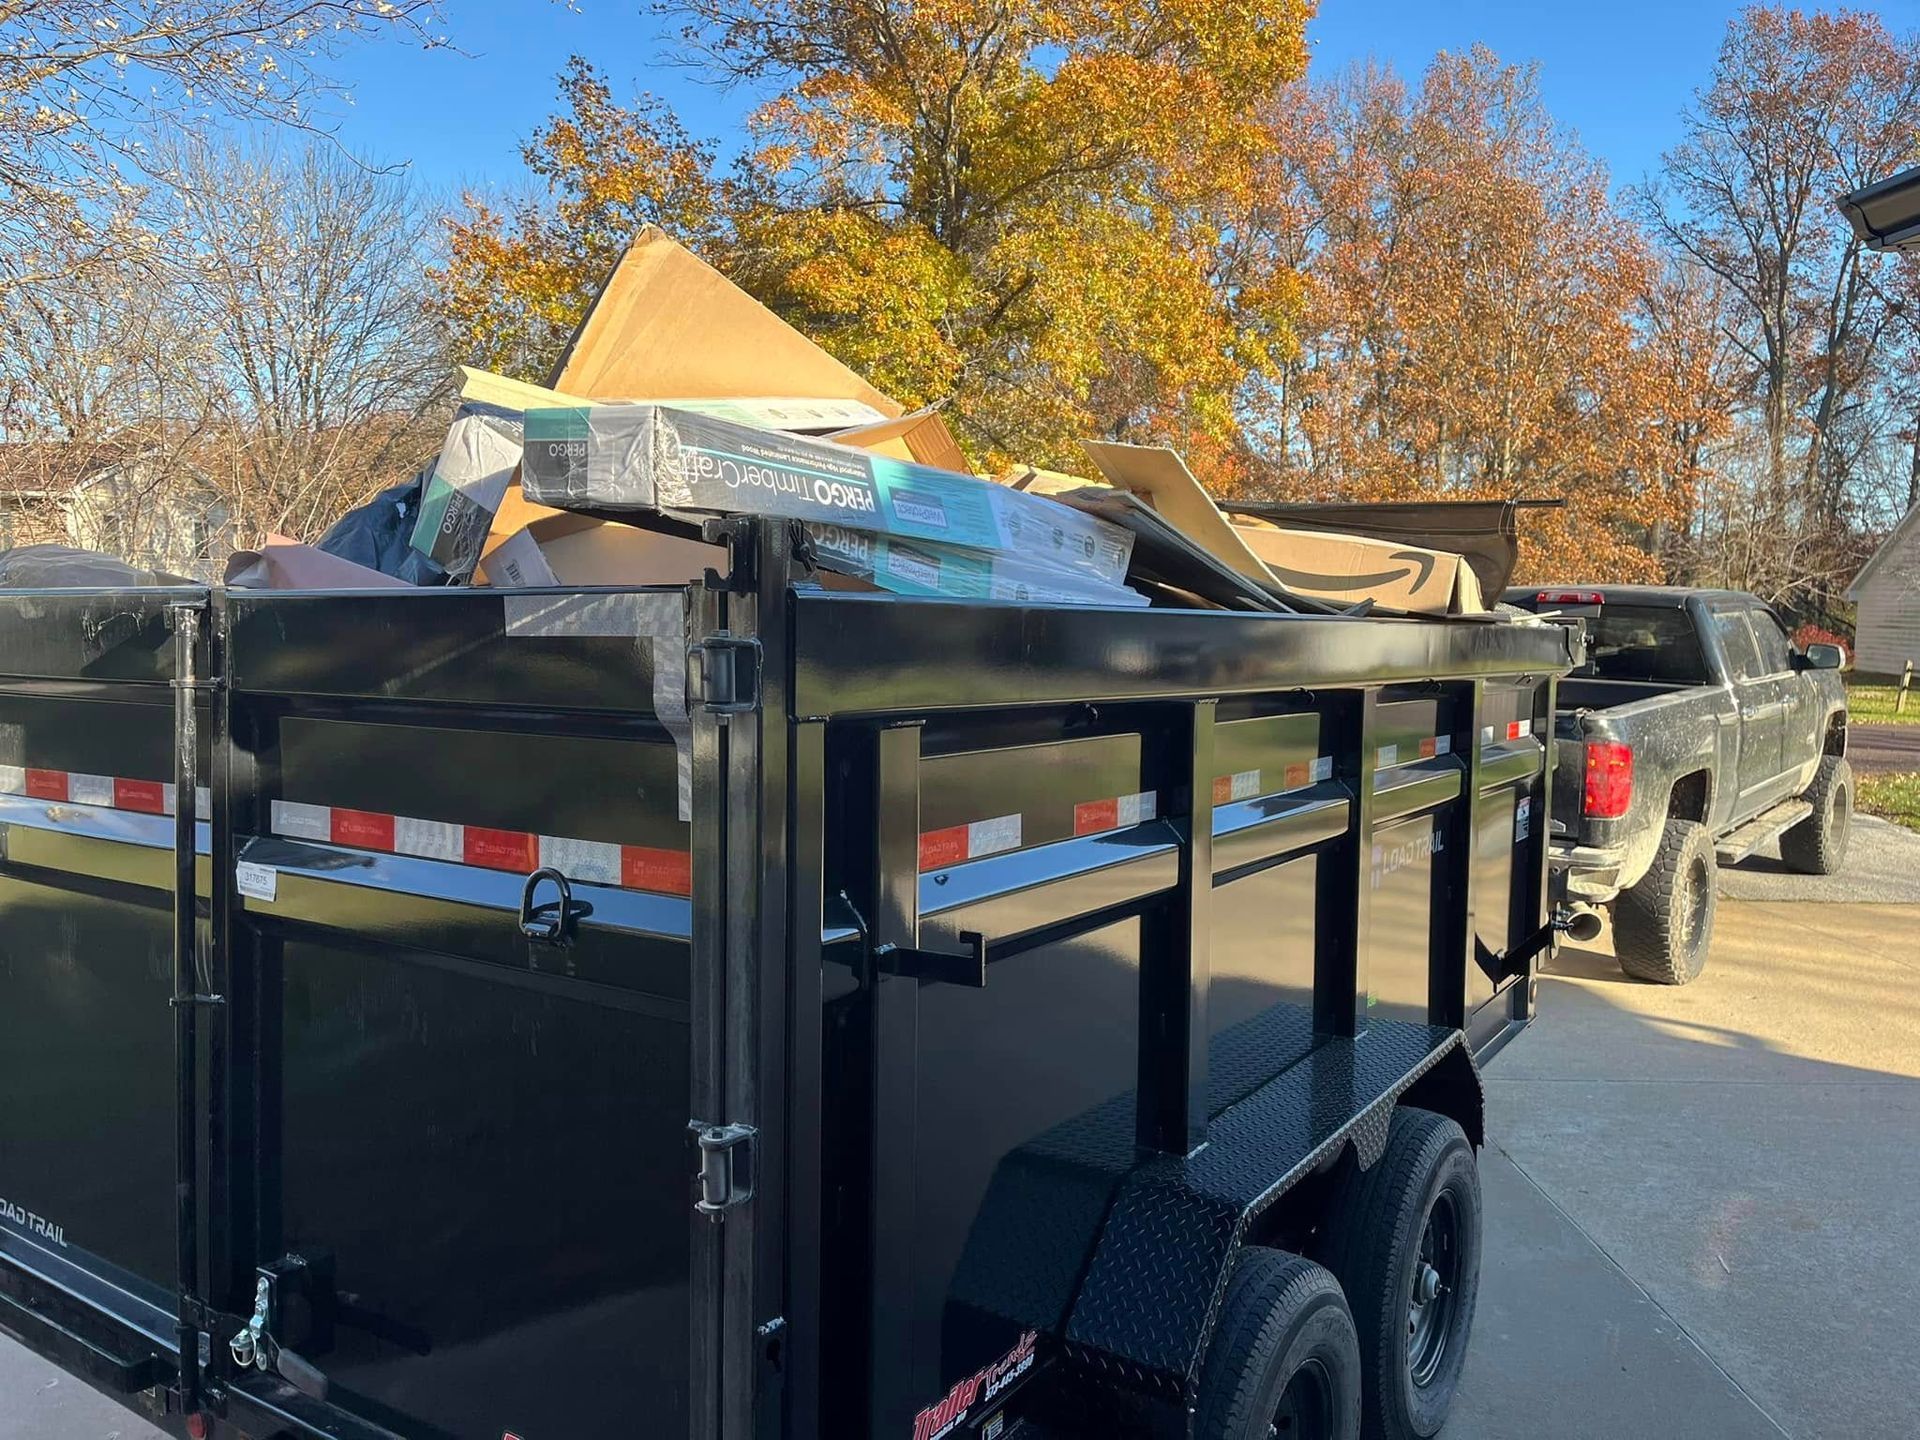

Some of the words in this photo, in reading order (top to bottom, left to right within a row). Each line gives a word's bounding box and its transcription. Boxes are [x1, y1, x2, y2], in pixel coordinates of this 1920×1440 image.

[549, 443, 586, 457] PERGO
[680, 450, 815, 502] TimberCraft
[815, 479, 877, 513] PERGO
[443, 491, 464, 534] PERGO
[0, 1197, 26, 1226] OAD
[27, 1211, 68, 1248] TRAIL
[913, 1369, 985, 1440] Trailer
